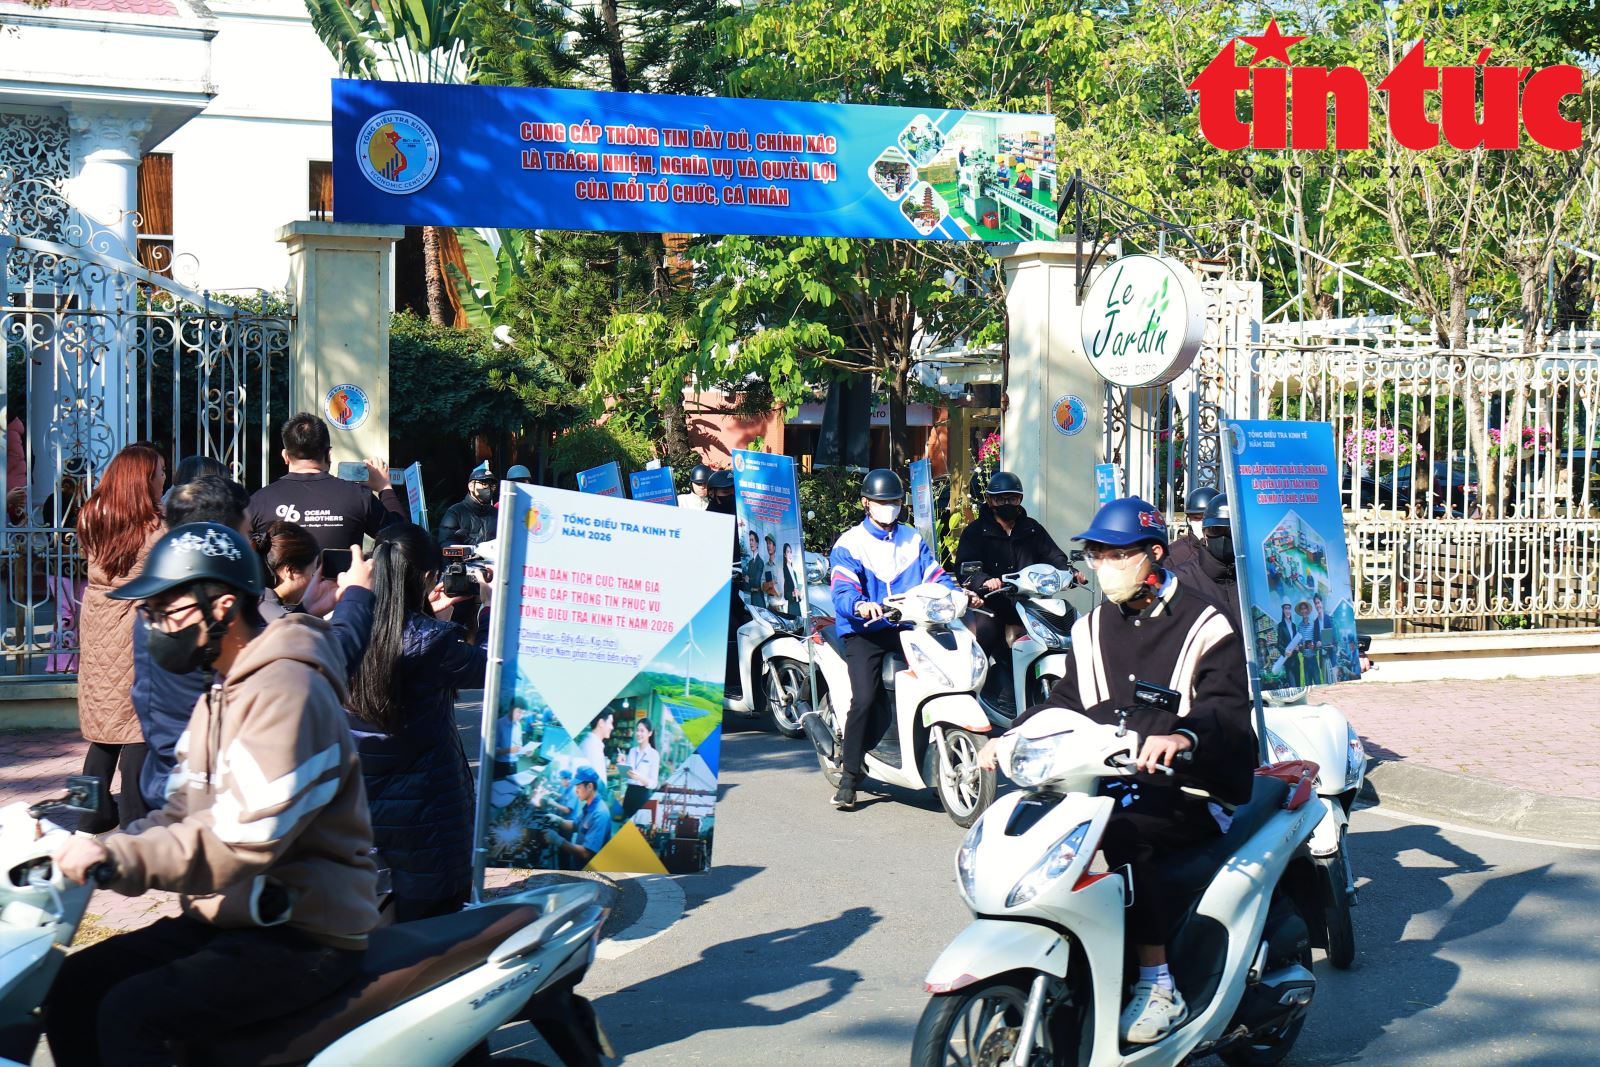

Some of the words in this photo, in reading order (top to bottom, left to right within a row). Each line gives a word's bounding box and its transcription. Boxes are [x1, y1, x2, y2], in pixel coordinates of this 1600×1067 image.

[411, 122, 426, 137] KINH
[520, 122, 566, 143] CUNG
[569, 120, 601, 144] CẤP
[606, 125, 658, 146] THÔNG
[663, 128, 688, 147] TIN
[693, 125, 723, 149] ĐẦY
[727, 129, 752, 152] ĐỦ,
[756, 131, 802, 153] CHÍNH
[807, 133, 836, 154] XÁC
[522, 150, 542, 170] LÀ
[546, 150, 598, 171] TRÁCH
[602, 152, 656, 176] NHIỆM,
[660, 154, 708, 175] NGHĨA
[711, 158, 733, 181] VỤ
[737, 158, 758, 178] VÀ
[762, 157, 808, 179] QUYỀN
[813, 160, 836, 184] LỢI
[371, 170, 403, 188] ECONOMIC
[404, 173, 427, 188] CENSUS
[576, 178, 608, 200] CỦA
[613, 177, 643, 201] MỖI
[648, 178, 668, 202] TỔ
[672, 182, 719, 206] CHỨC,
[723, 184, 744, 205] CÁ
[748, 185, 789, 207] NHÂN
[1107, 265, 1134, 308] Le
[1093, 309, 1168, 358] Jardin
[588, 531, 612, 542] 2026
[620, 522, 640, 533] TRA
[642, 526, 666, 536] KINH
[668, 528, 682, 538] TẾ
[521, 585, 546, 599] CUNG
[605, 595, 619, 607] TIN
[617, 577, 641, 591] THAM
[645, 580, 660, 593] GIA
[572, 610, 588, 623] TRA
[592, 613, 613, 626] KINH
[651, 620, 674, 633] 2026
